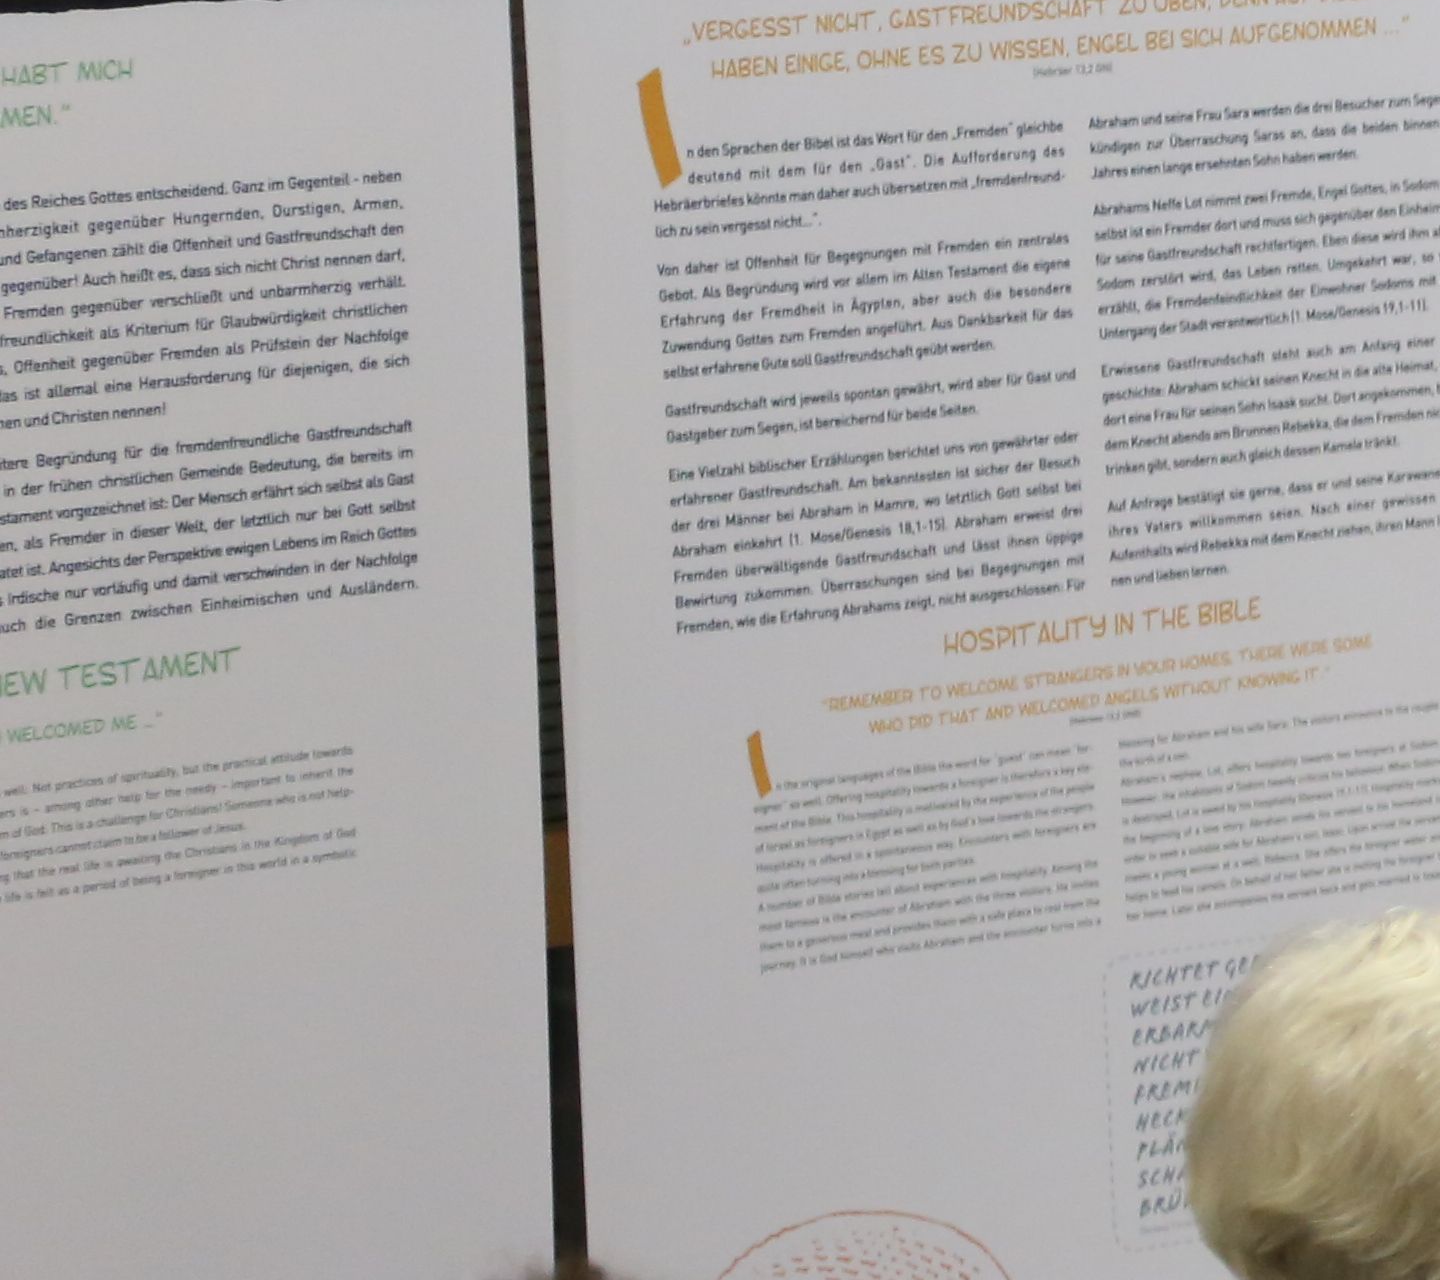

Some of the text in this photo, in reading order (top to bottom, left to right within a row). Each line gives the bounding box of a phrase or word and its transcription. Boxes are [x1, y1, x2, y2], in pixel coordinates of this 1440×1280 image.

[711, 56, 779, 78] HABEN
[856, 47, 911, 69] OHNE
[918, 45, 945, 66] ES
[952, 43, 983, 64] ZU
[1075, 33, 1139, 56] ENGEL
[1145, 30, 1175, 51] BEI
[1180, 28, 1223, 48] SICH
[1229, 18, 1377, 44] AUFGENOMMEN
[1, 59, 133, 85] HABT MICH
[3, 198, 28, 211] des
[31, 195, 86, 208] Reiches
[88, 191, 133, 204] Gottes
[231, 181, 265, 194] Ganz
[267, 181, 285, 190] im
[287, 174, 350, 191] Gegenteil
[362, 171, 402, 183] neben
[3, 305, 65, 318] Fremden
[70, 299, 144, 317] gegenüber
[150, 290, 223, 307] verschließt
[229, 288, 255, 301] und
[260, 283, 352, 298] unbarmherzig
[664, 397, 768, 417] Gastfreundschaft
[770, 395, 797, 407] wird
[799, 391, 841, 407] jeweils
[844, 388, 890, 402] spontan
[947, 378, 974, 391] wird
[976, 377, 1003, 389] aber
[1006, 374, 1023, 386] für
[1026, 372, 1052, 384] Gast
[1054, 368, 1077, 381] und
[943, 596, 1261, 653] HOSPITALITY IN THE BIBLE
[58, 647, 241, 687] TESTAMENT
[7, 714, 137, 742] WELCOMED ME
[1131, 988, 1197, 1018] WEIST
[1133, 1050, 1199, 1074] NICHT
